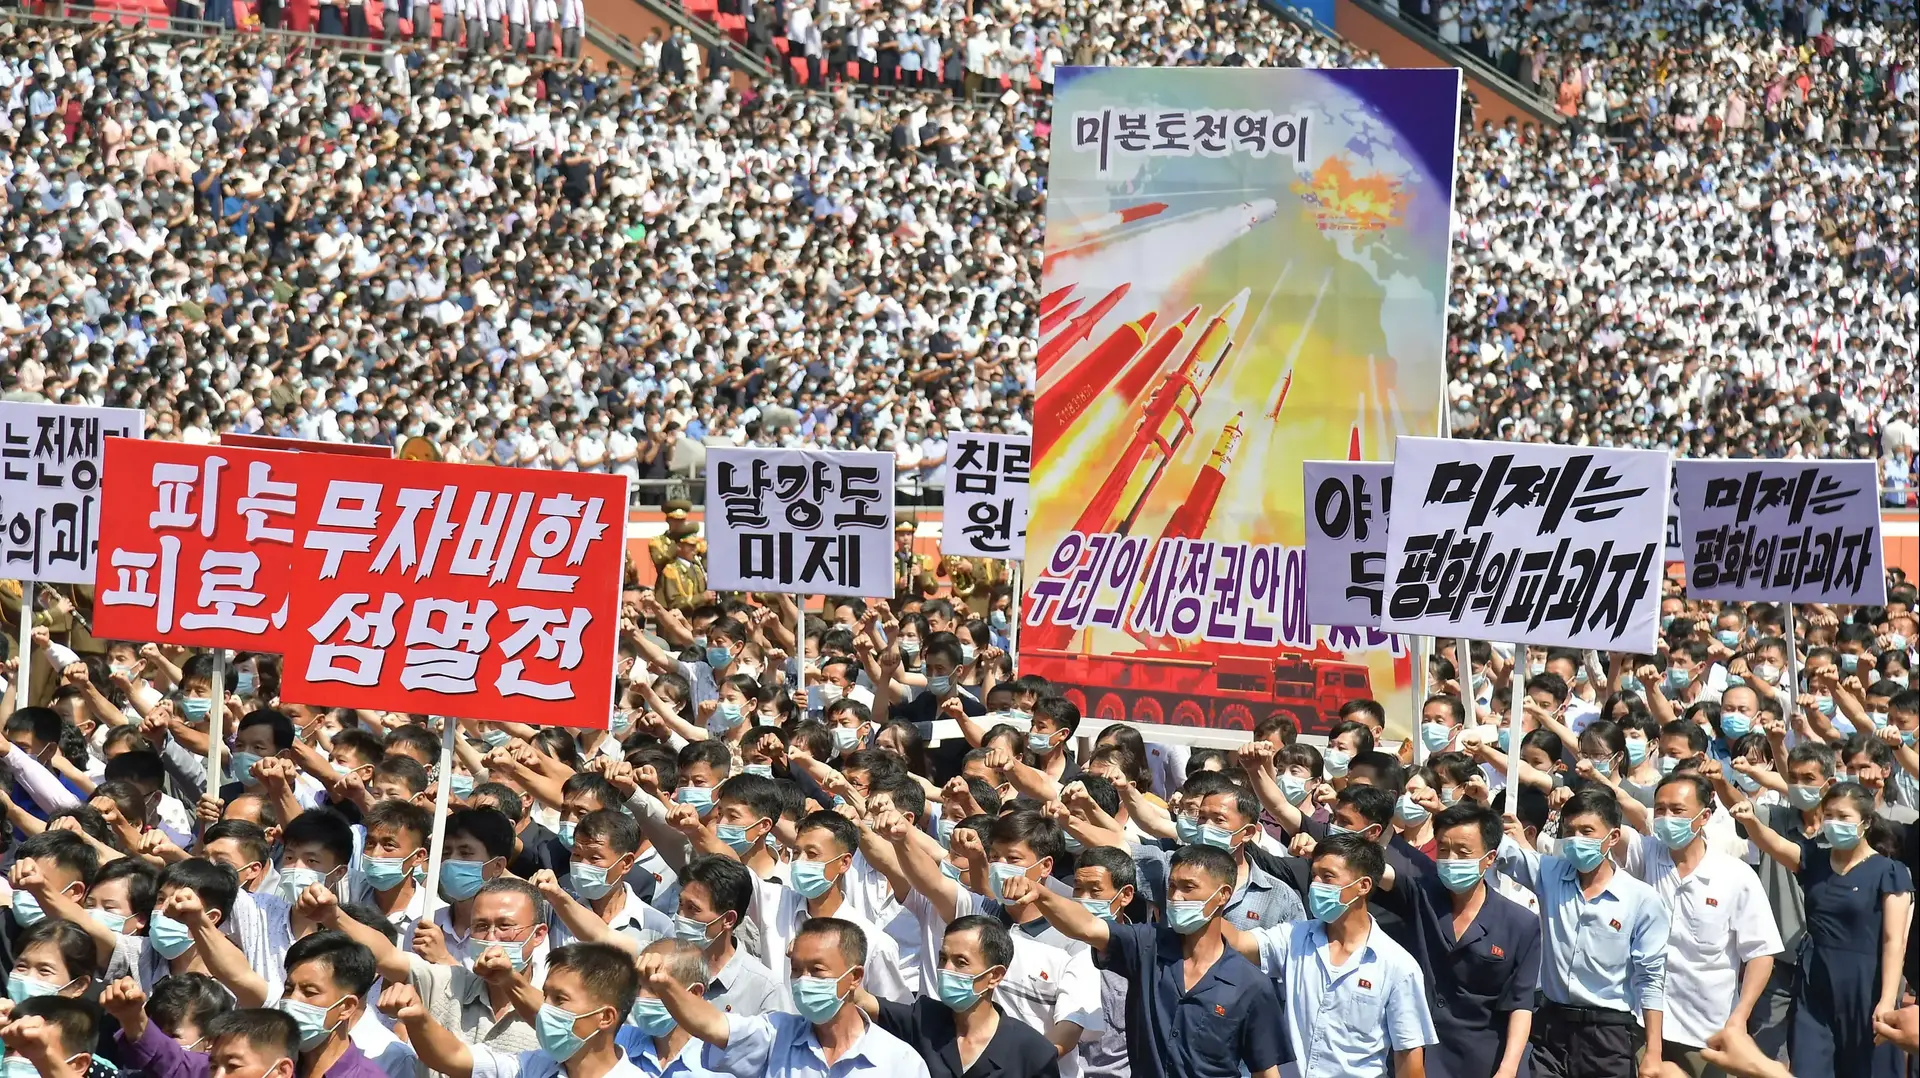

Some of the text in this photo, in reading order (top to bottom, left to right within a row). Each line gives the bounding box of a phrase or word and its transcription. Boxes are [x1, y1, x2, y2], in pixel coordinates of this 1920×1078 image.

[148, 455, 298, 543] 피는
[717, 458, 889, 530] 날강도
[1315, 474, 1393, 541] 야
[1423, 454, 1650, 535] 미제는
[1702, 468, 1861, 527] 미제는
[303, 480, 609, 593] 무자비한
[739, 532, 861, 588] 미제
[102, 536, 290, 635] 피로
[304, 592, 593, 701] 섬멸전
